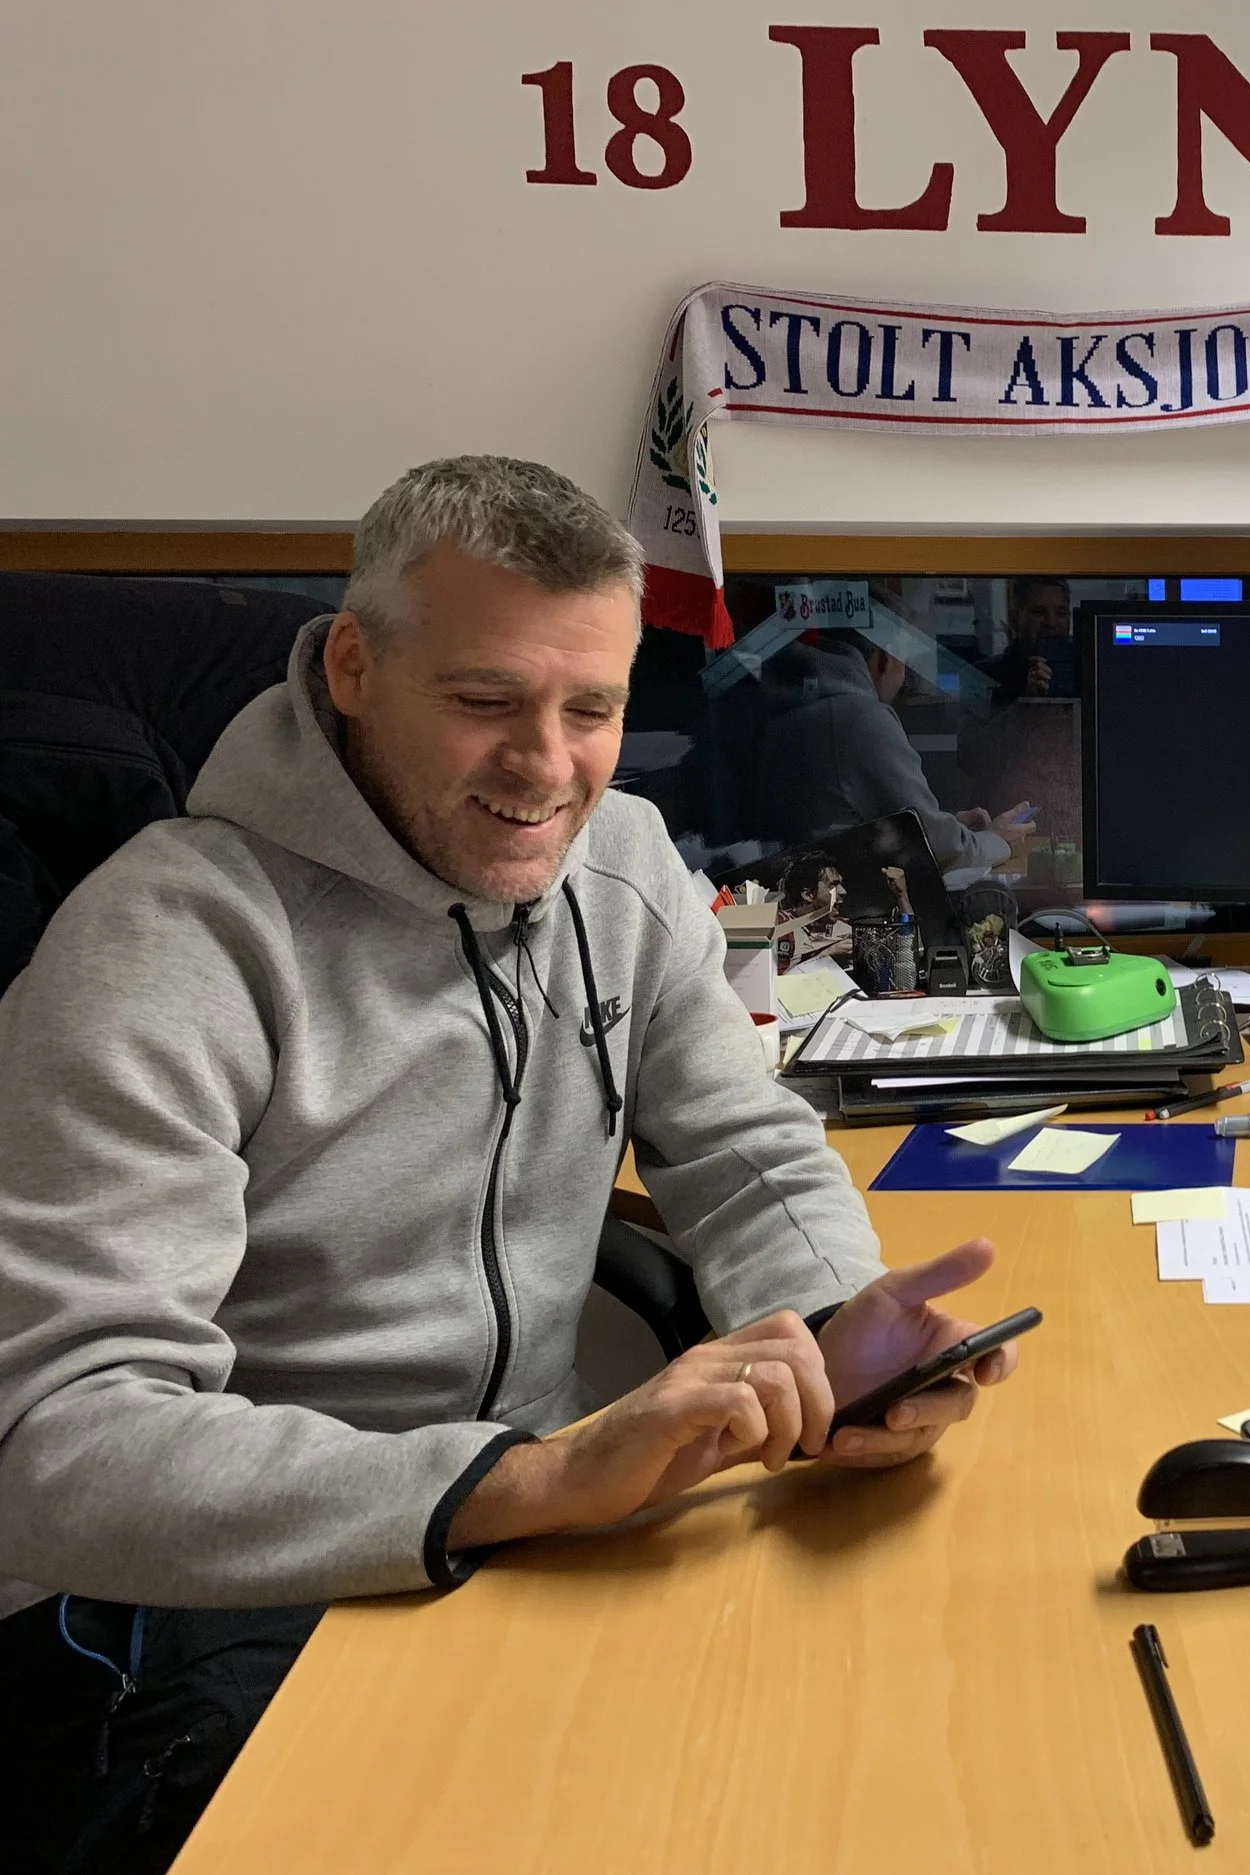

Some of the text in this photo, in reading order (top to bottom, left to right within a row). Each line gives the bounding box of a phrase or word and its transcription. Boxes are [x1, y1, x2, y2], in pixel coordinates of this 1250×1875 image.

[520, 61, 693, 190] 18
[720, 303, 972, 403] STOLT
[800, 590, 865, 620] Brustad Bua
